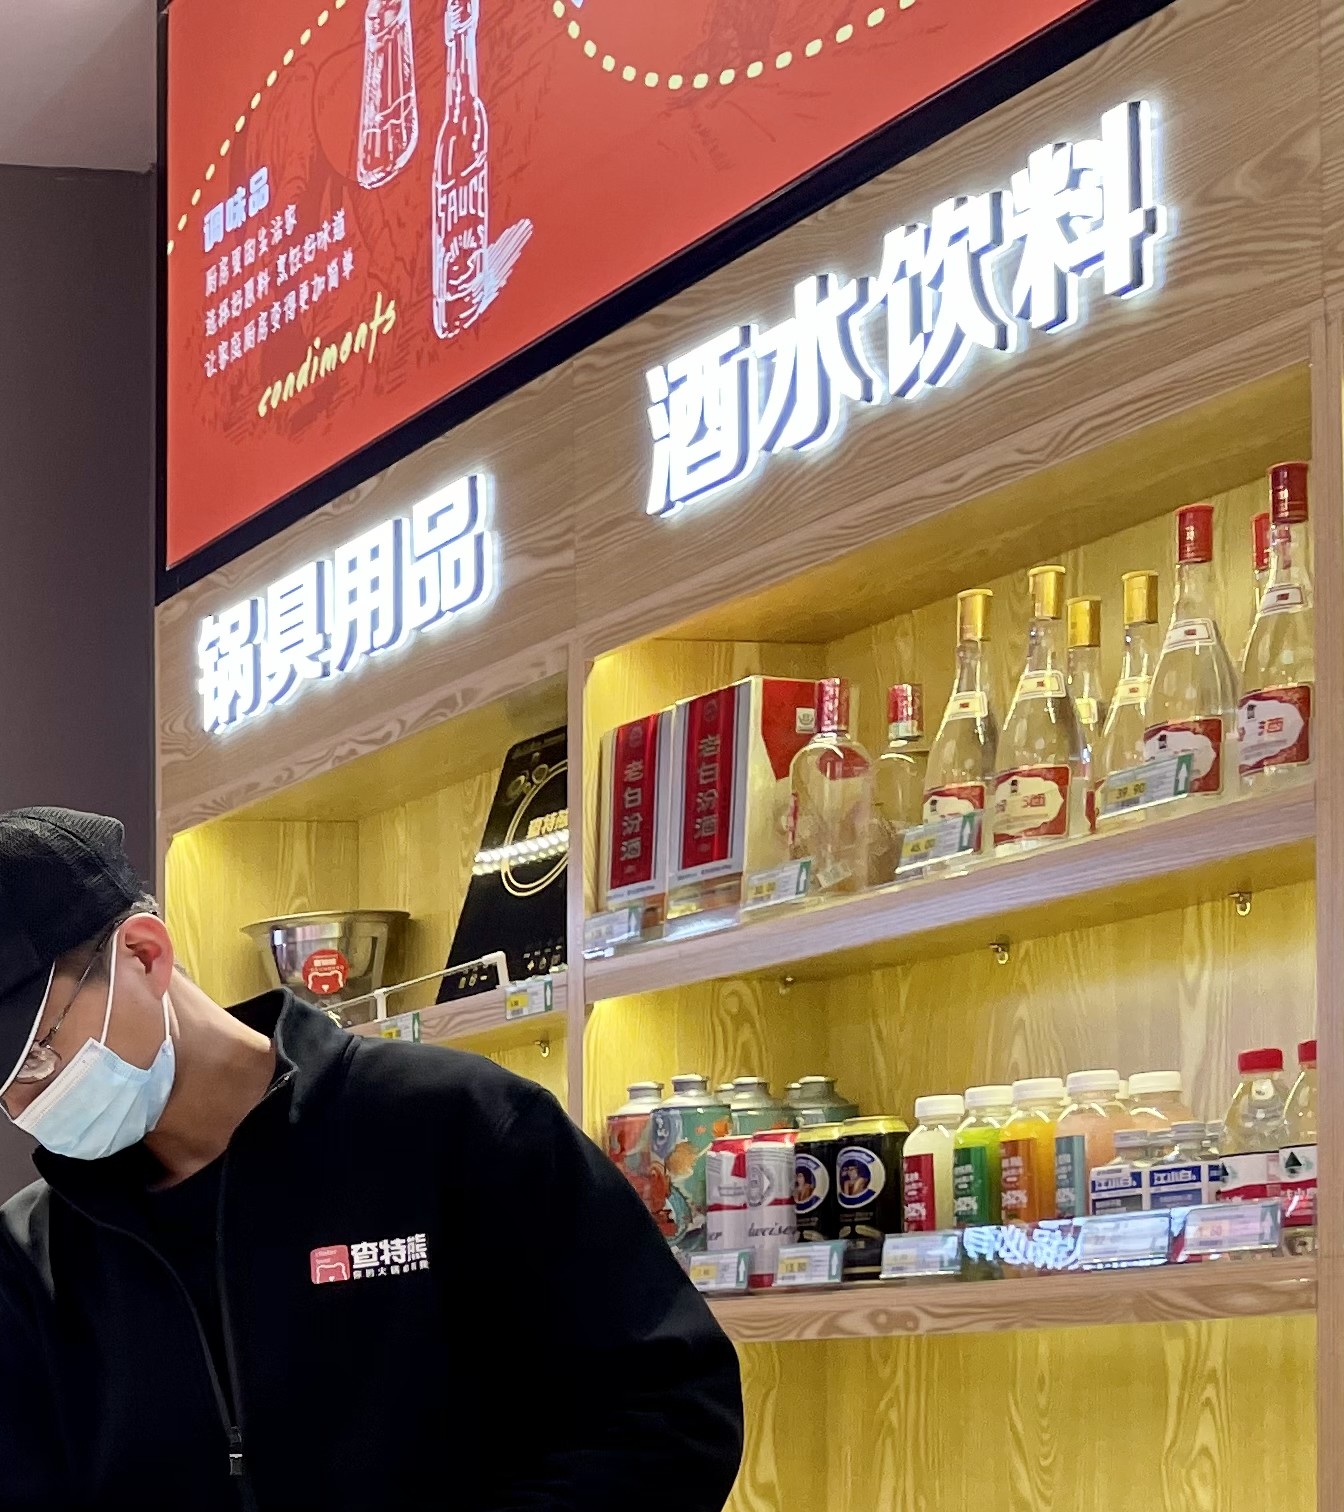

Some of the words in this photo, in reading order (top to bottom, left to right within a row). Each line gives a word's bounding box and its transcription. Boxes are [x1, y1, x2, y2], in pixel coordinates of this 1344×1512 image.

[203, 166, 269, 252] 调味品
[258, 291, 396, 417] condiments
[646, 100, 1166, 517] 酒水饮料
[197, 474, 494, 732] 锅具用品
[351, 1233, 428, 1269] 查特熊
